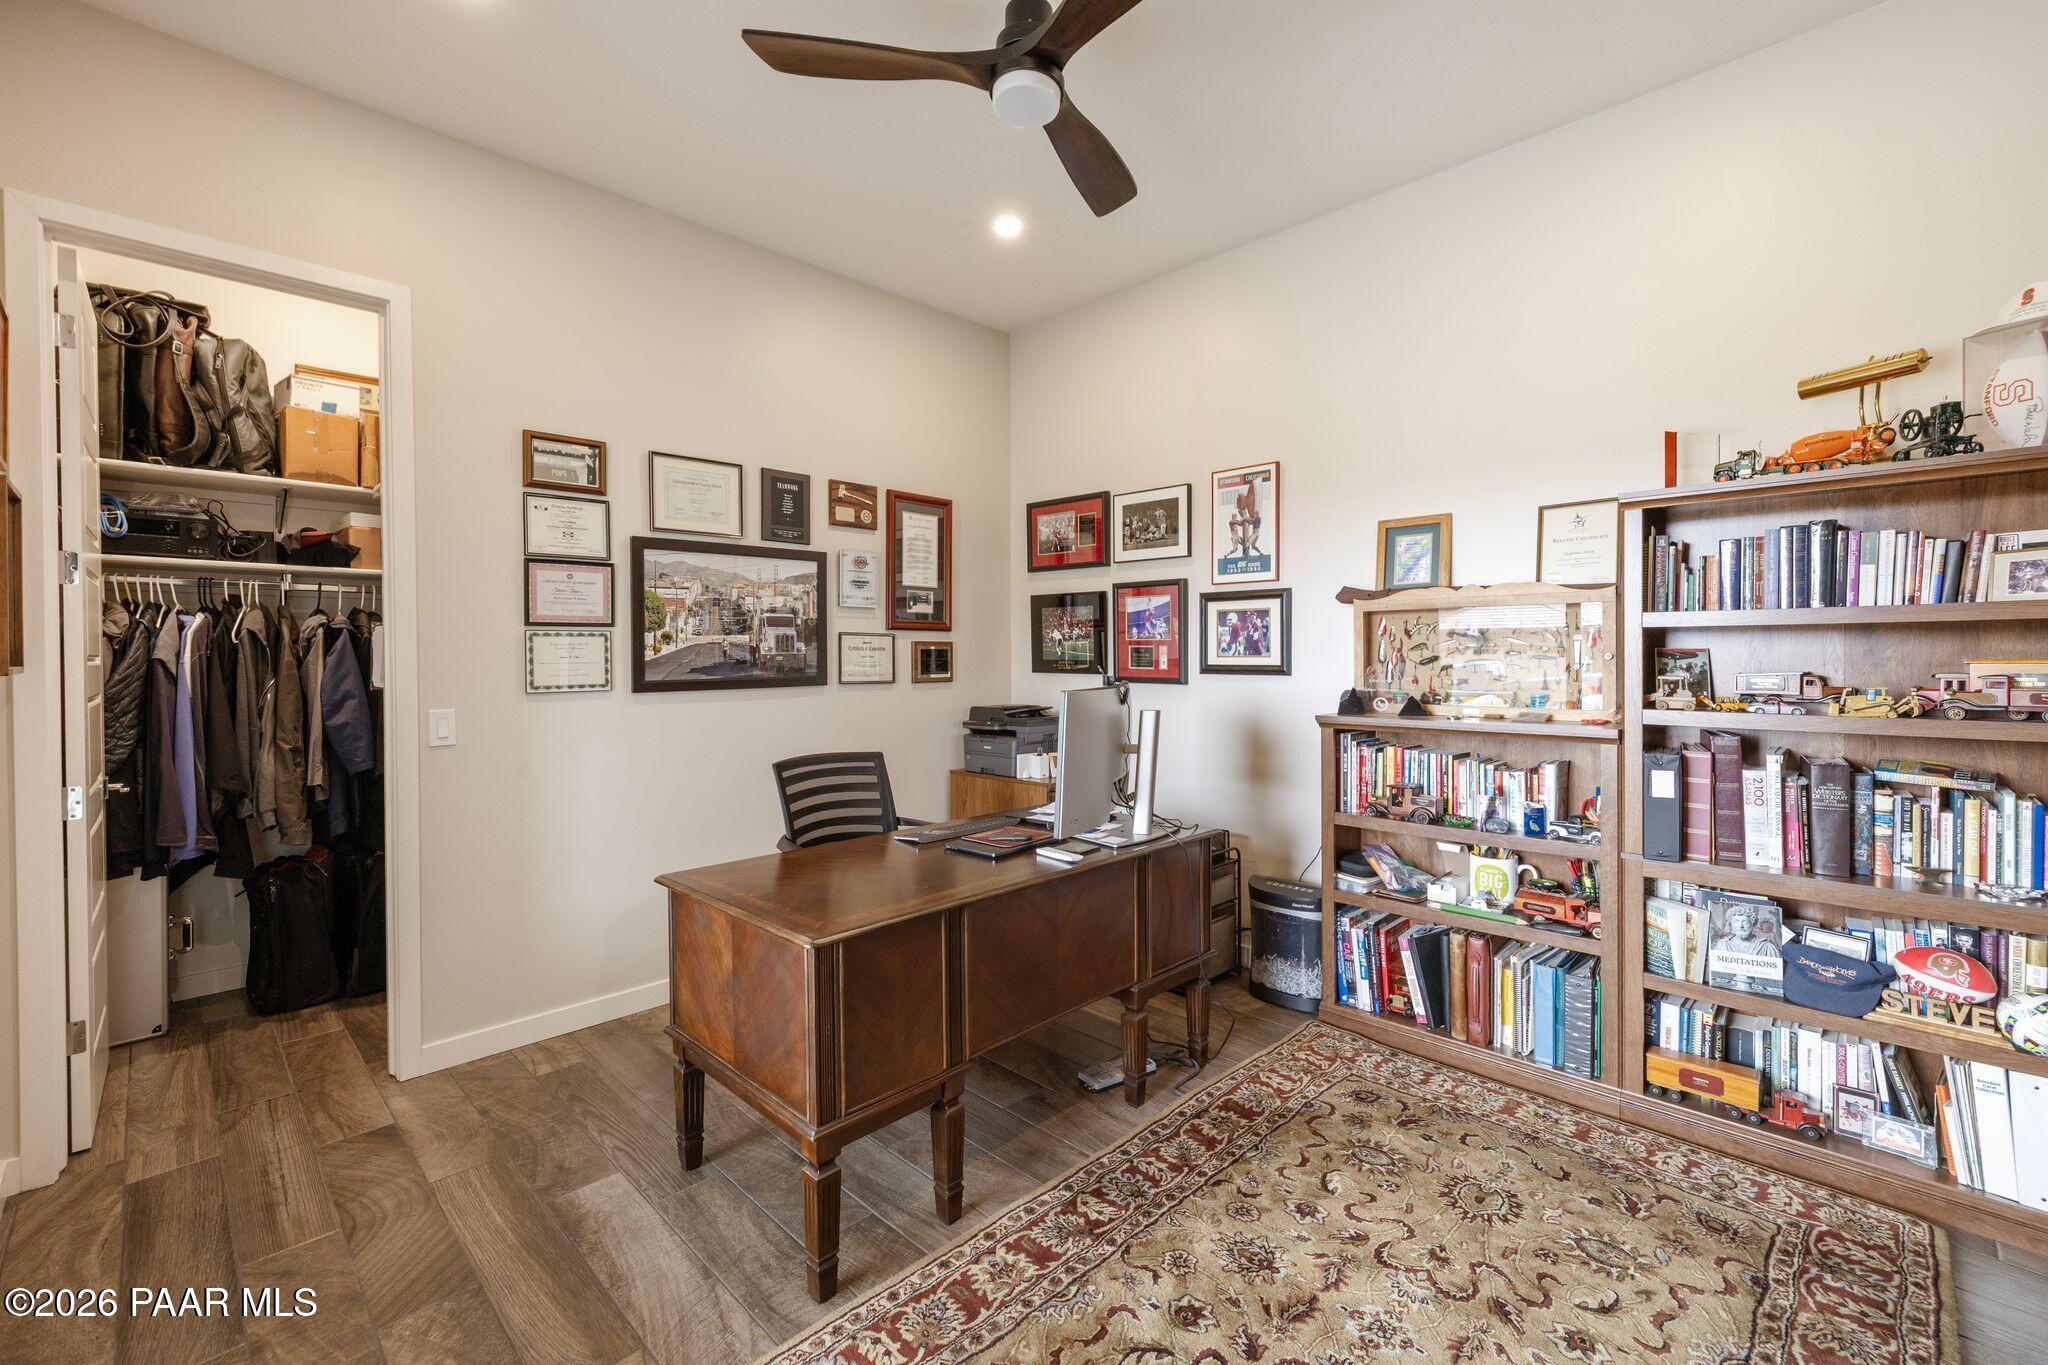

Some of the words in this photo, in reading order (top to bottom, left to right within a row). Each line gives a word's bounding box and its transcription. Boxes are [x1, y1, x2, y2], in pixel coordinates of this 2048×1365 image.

[1744, 776, 1753, 806] ASANAS
[1480, 872, 1503, 889] BIG
[1358, 949, 1367, 967] STUFF
[1717, 954, 1778, 969] MEDITATIONS
[1881, 988, 1996, 1033] STEVE
[1890, 1071, 1904, 1090] RAMSEY
